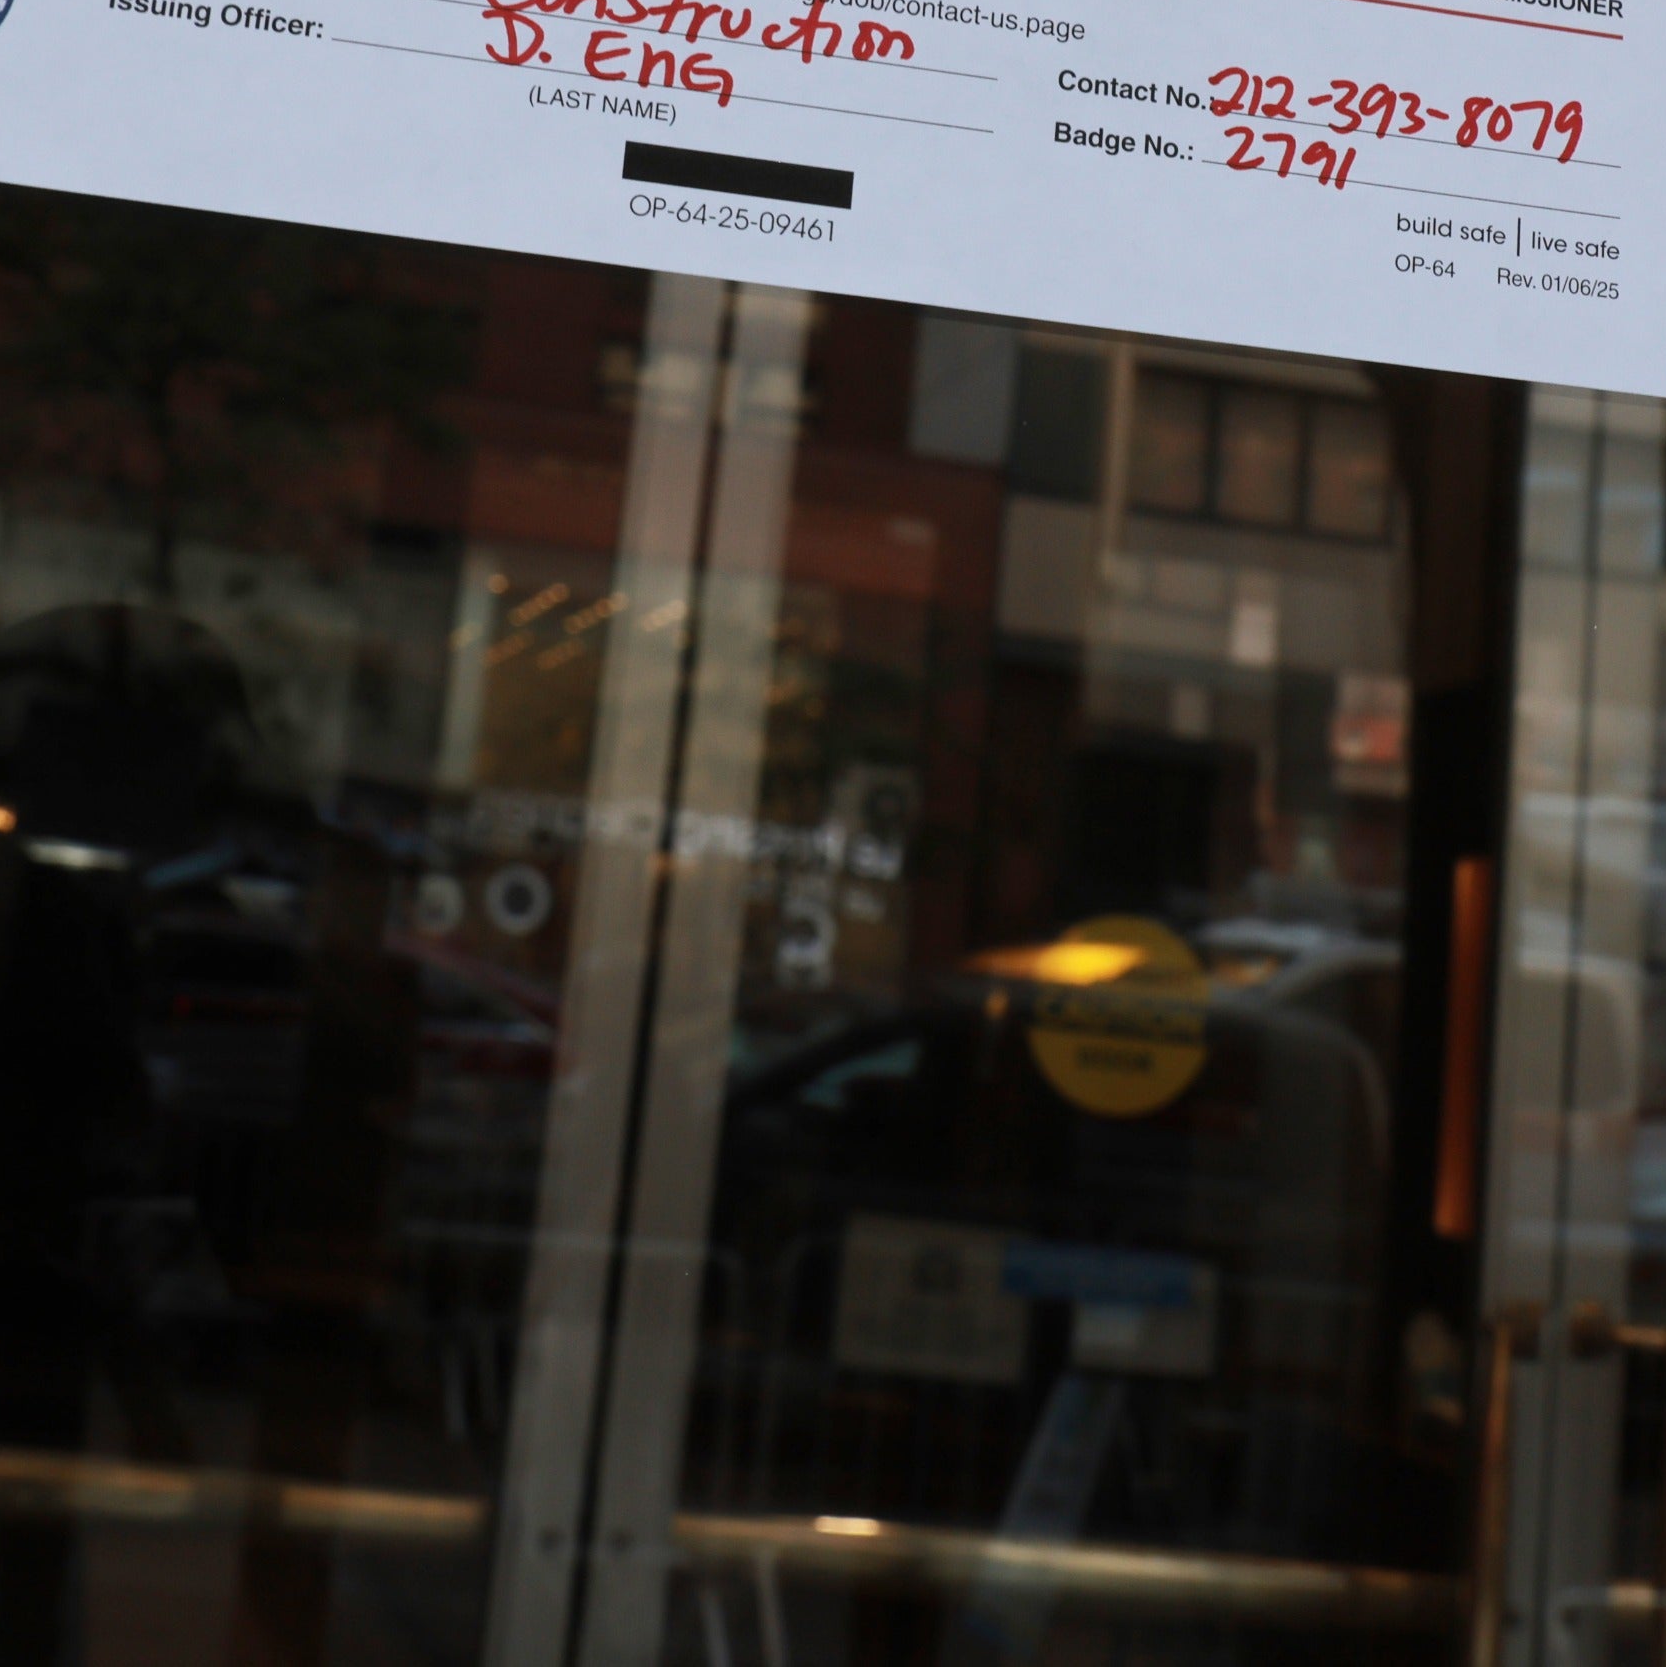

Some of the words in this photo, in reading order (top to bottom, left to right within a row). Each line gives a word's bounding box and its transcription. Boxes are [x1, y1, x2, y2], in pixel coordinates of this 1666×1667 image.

[221, 4, 323, 38] Officer:
[483, 9, 551, 65] D.
[529, 86, 596, 110] (LAST
[602, 95, 676, 126] NAME)
[1059, 70, 1157, 103] Contact
[1209, 67, 1583, 163] 212-393-8079
[1054, 122, 1135, 155] Badge
[1145, 134, 1193, 160] No.:
[1225, 126, 1356, 189] 2791
[630, 195, 833, 241] OP-64-25-09461
[1397, 213, 1452, 237] build
[1461, 225, 1506, 244] safe
[1532, 231, 1567, 252] live
[1575, 241, 1619, 260] safe
[1395, 254, 1455, 278] OP-64
[1498, 268, 1536, 288] Rev.
[1542, 274, 1619, 299] 01/06/25
